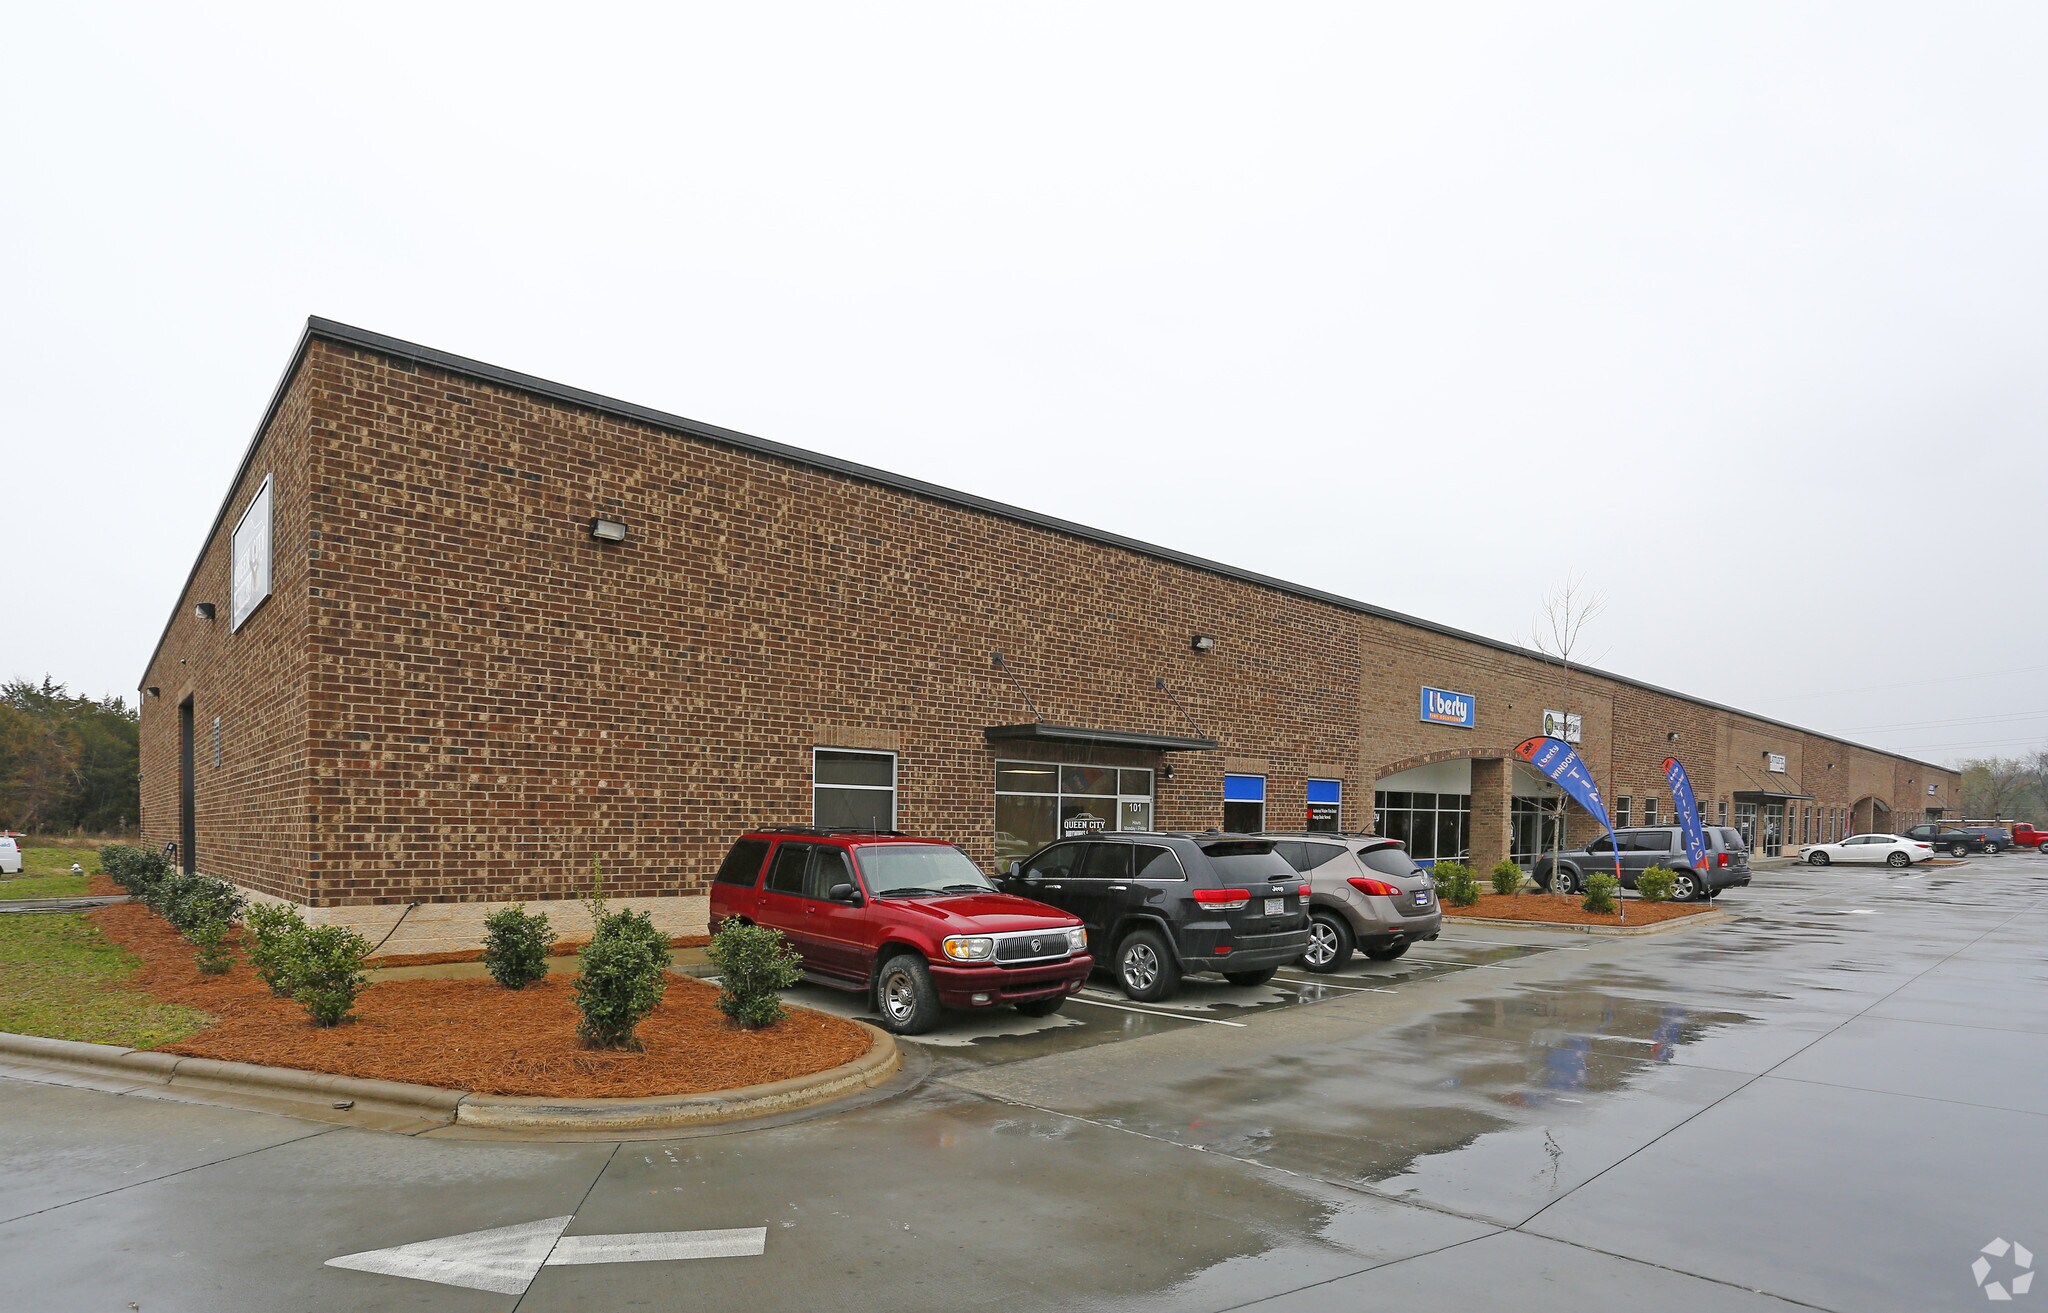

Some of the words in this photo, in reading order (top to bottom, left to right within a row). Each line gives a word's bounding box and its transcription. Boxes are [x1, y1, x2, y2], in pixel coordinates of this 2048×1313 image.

[1523, 742, 1534, 754] 3M
[1551, 751, 1577, 779] WINDOW
[1129, 803, 1141, 812] 101
[1064, 820, 1087, 829] QUEEN
[1089, 821, 1105, 829] CITY
